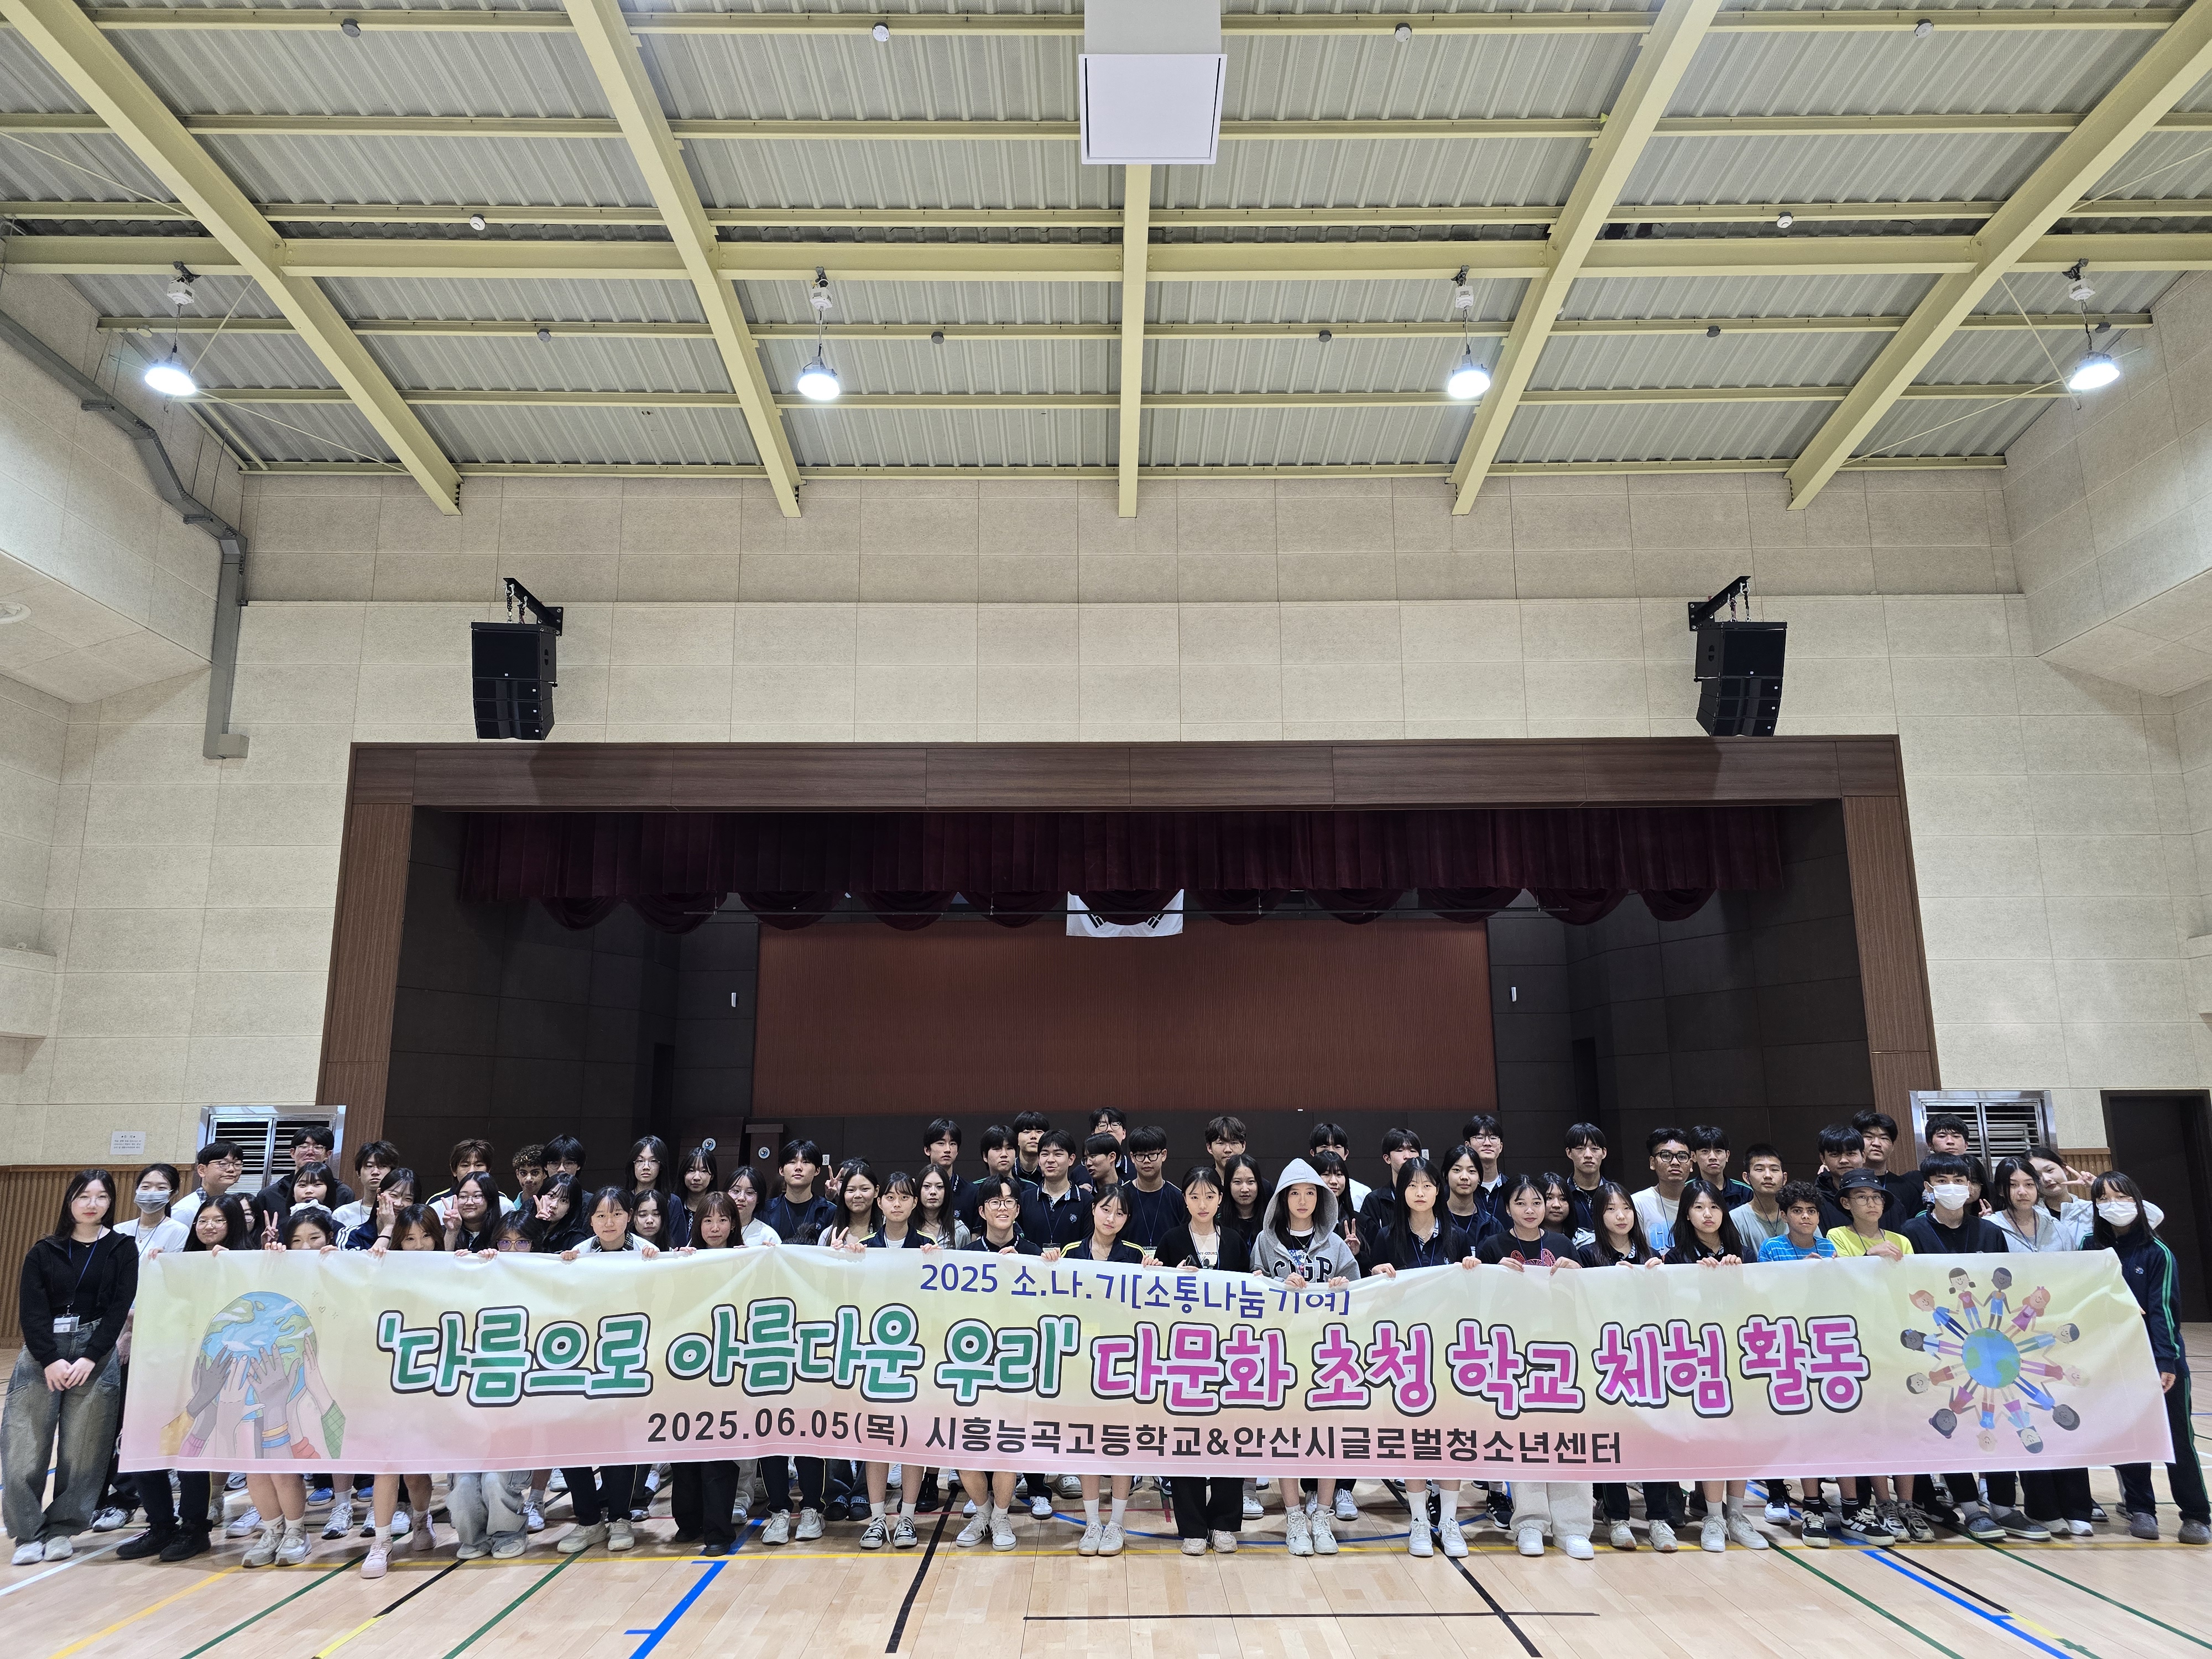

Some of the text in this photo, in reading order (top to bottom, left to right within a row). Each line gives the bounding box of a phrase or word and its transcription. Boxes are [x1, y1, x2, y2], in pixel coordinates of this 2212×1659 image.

[920, 1263, 998, 1293] 2025
[666, 1296, 926, 1404] 아름다운
[1090, 1321, 1298, 1417] 다문화
[1305, 1319, 1437, 1417] 초청
[1445, 1318, 1586, 1421] 학교
[1591, 1318, 1734, 1419] 체험
[1737, 1314, 1871, 1416] 활동
[647, 1407, 1621, 1464] 2025.06.05(목) 시흥능곡고등학교&안산시글로벌청소년센터
